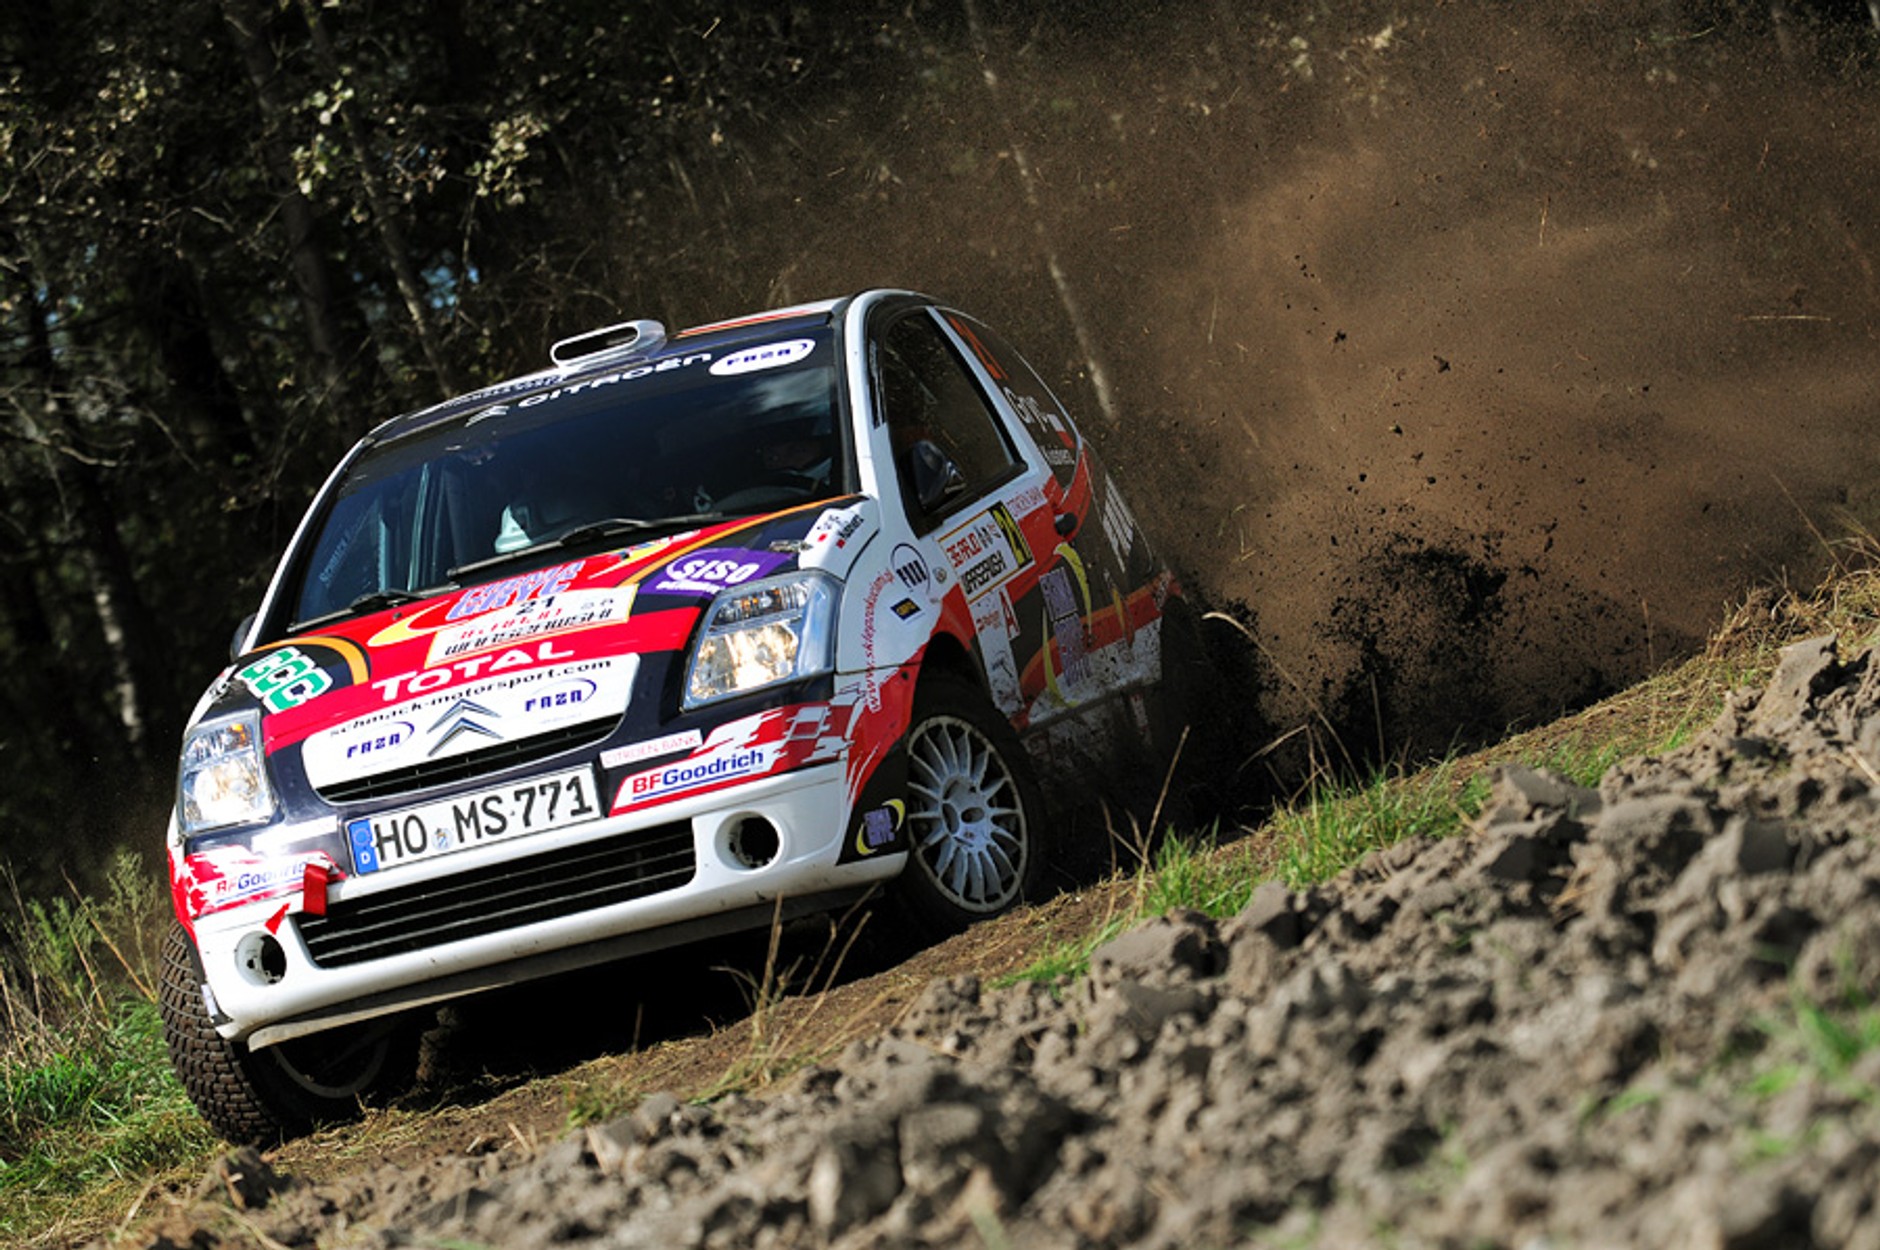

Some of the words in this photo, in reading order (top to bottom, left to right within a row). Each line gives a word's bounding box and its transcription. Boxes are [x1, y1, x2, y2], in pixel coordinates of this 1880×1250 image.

[992, 505, 1033, 569] 21
[516, 596, 556, 616] 21
[373, 642, 575, 701] TOTAL
[330, 658, 612, 738] schmack-motorsport.com
[524, 689, 583, 713] FAZA
[346, 732, 401, 759] FAZA
[632, 750, 764, 795] BFGoodrich
[360, 851, 371, 865] D
[373, 814, 429, 862] HO
